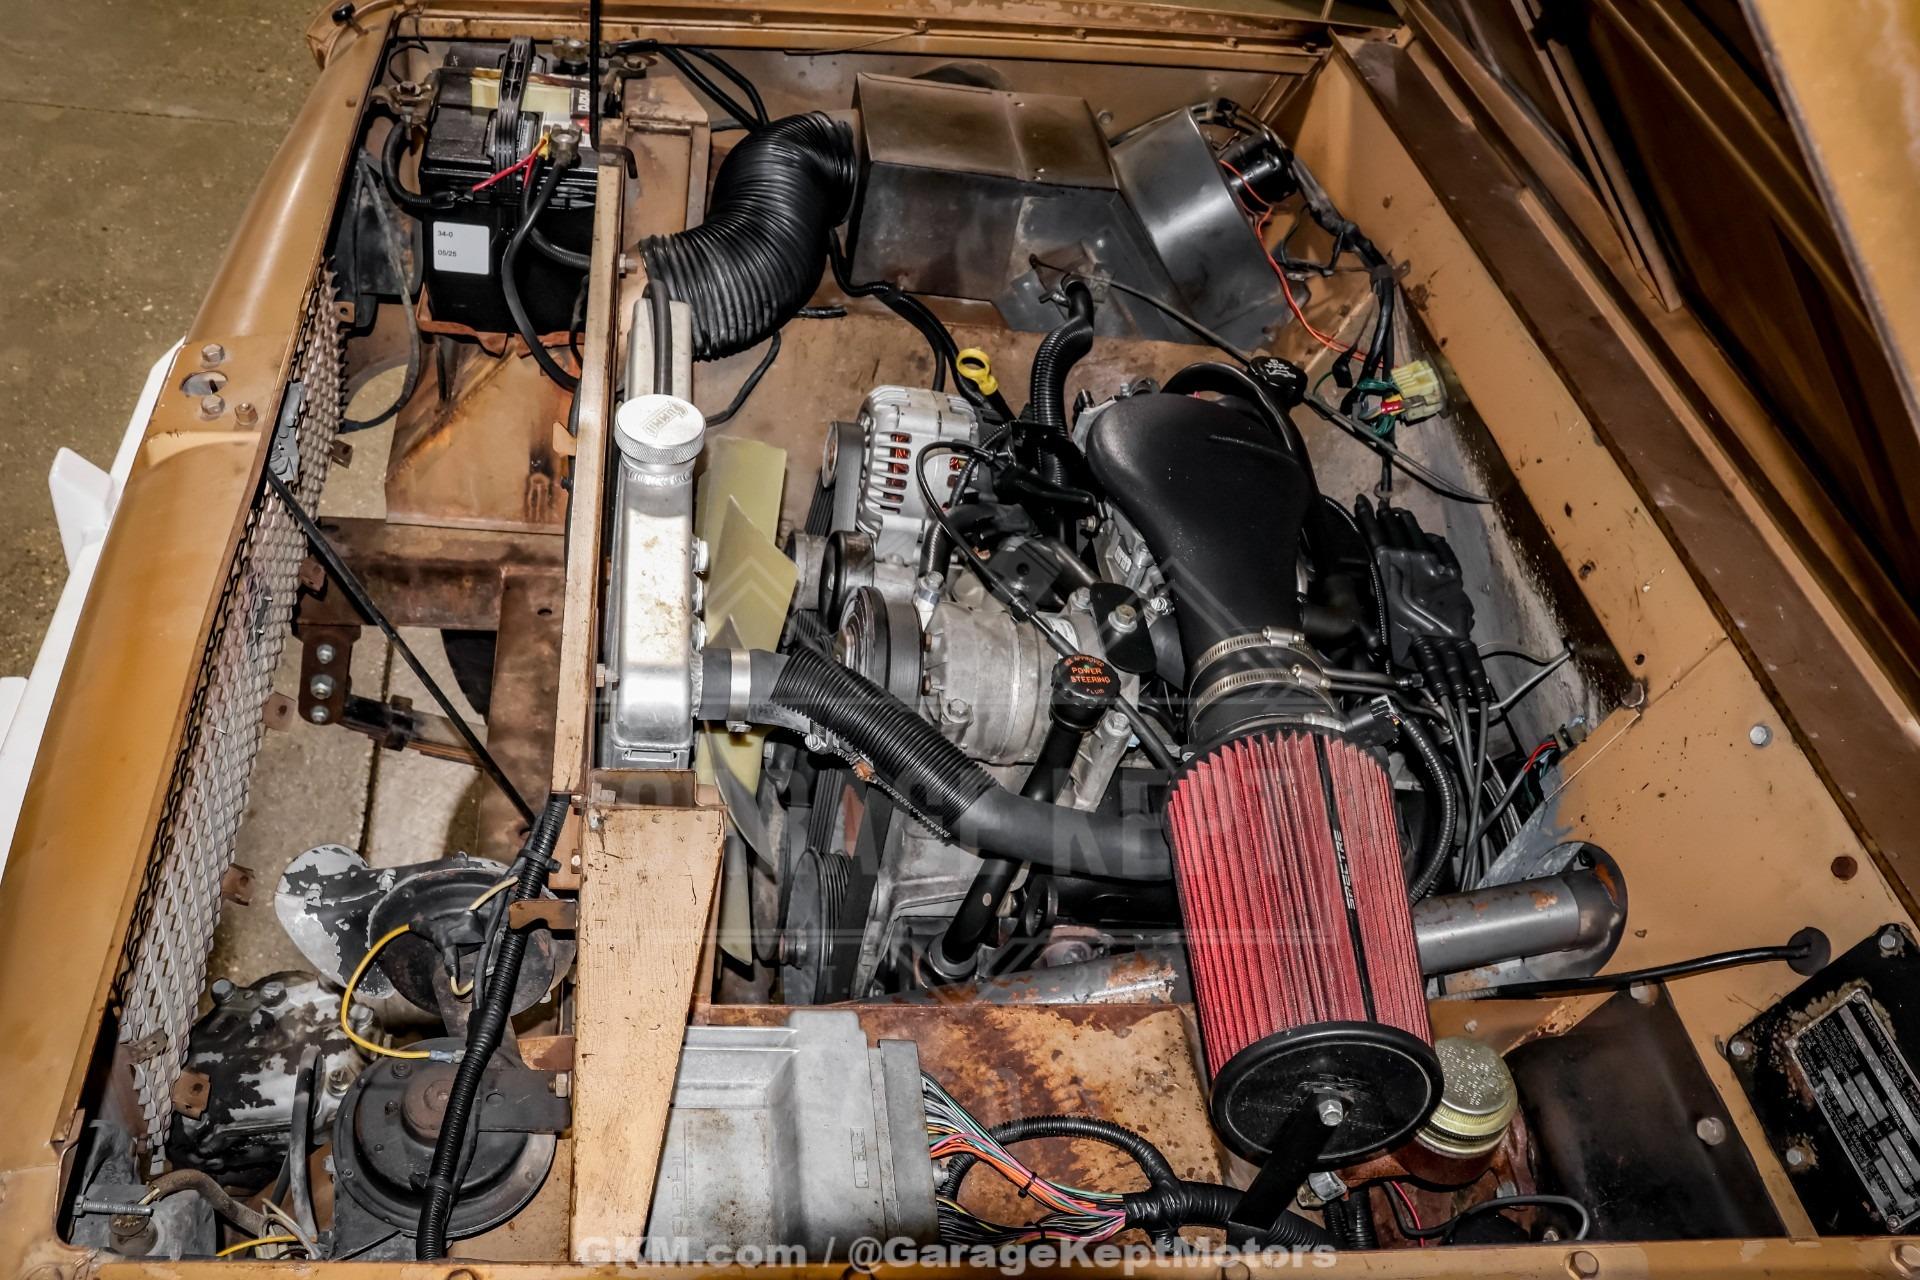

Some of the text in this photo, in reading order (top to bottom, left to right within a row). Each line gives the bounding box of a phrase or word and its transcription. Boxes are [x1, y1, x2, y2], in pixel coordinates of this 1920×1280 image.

[1070, 675, 1111, 685] STEERING
[1071, 667, 1103, 675] POWER
[1333, 830, 1356, 911] SPECTRE
[1857, 1004, 1909, 1083] INTERNATIONAL
